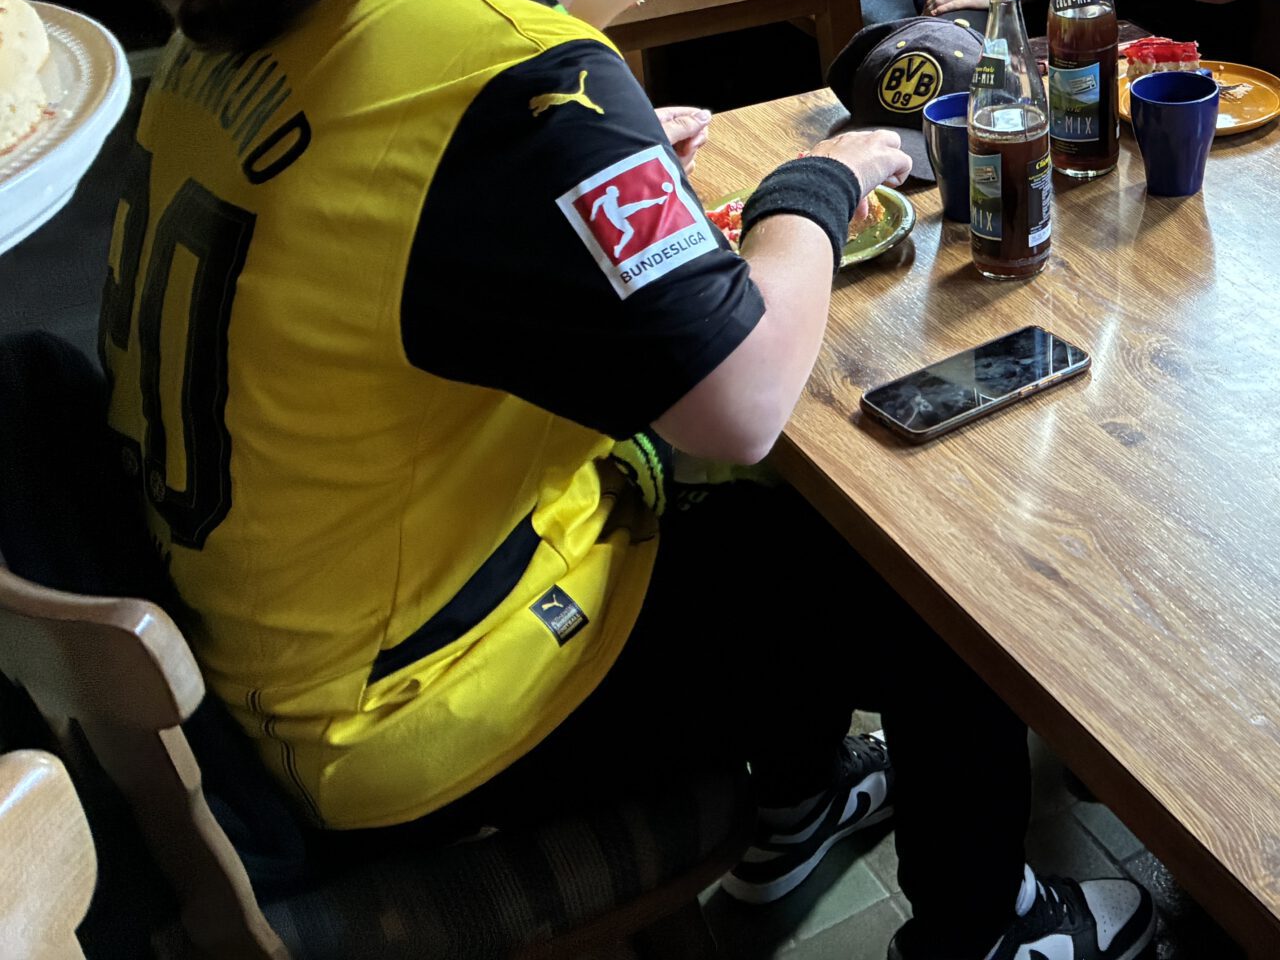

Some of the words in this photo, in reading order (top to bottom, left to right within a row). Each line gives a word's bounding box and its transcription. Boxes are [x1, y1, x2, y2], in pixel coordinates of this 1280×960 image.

[884, 57, 935, 97] BVB
[891, 90, 913, 107] 09
[619, 231, 706, 284] BUNDESLIGA
